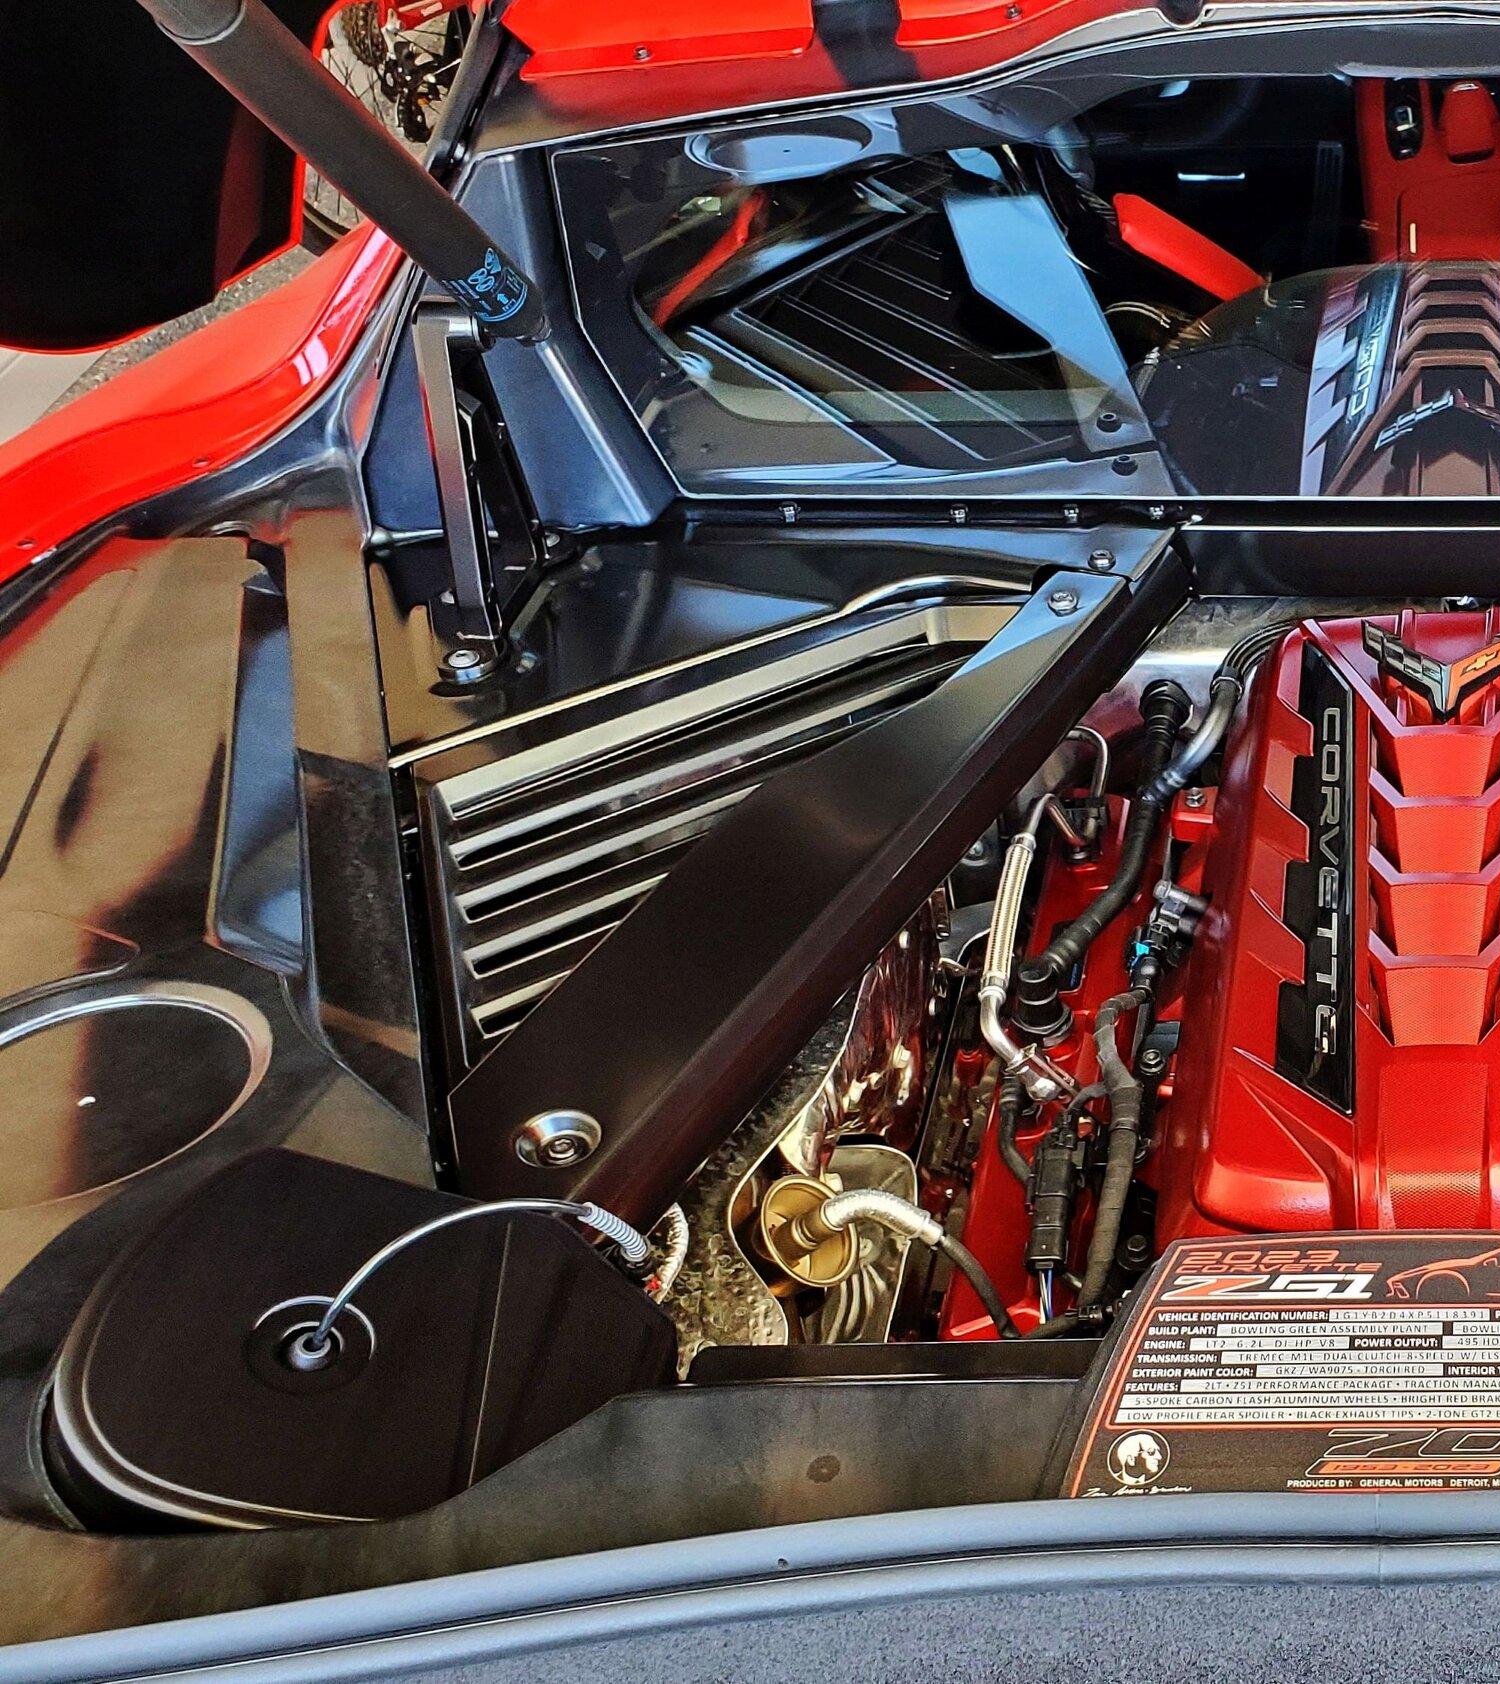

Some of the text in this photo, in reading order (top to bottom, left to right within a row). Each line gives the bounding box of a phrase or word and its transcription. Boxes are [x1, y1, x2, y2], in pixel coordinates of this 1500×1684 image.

[1314, 707, 1341, 1055] CORVETTE
[1181, 1249, 1340, 1265] 2023
[1174, 1262, 1383, 1273] CORVETTE
[1160, 1273, 1375, 1301] Z51
[1158, 1312, 1199, 1321] VEHICLE
[1201, 1311, 1279, 1321] IDENTIFICATION
[1280, 1311, 1329, 1320] NUMBER:
[1148, 1326, 1179, 1335] BUILD
[1181, 1326, 1216, 1335] PLANT:
[1230, 1325, 1285, 1334] BOWLING
[1289, 1325, 1327, 1334] GREEN
[1330, 1324, 1388, 1333] ASSEMBLY
[1392, 1324, 1428, 1333] PLANT
[1144, 1340, 1186, 1350] ENGINE:
[1206, 1340, 1226, 1348] LT2
[1237, 1340, 1263, 1348] 6.2L
[1354, 1338, 1393, 1347] POWER
[1394, 1338, 1438, 1347] OUTPUT:
[1457, 1337, 1478, 1346] 495
[1136, 1354, 1217, 1363] TRANSMISSION:
[1238, 1353, 1284, 1362] TREMEC
[1323, 1352, 1353, 1361] DUAL
[1357, 1352, 1400, 1360] CLUTCH
[1407, 1352, 1454, 1360] 8-SPEED
[1461, 1352, 1476, 1361] W/
[1132, 1368, 1181, 1378] EXTERIOR
[1183, 1368, 1213, 1377] PAINT
[1215, 1368, 1254, 1377] COLOR:
[1275, 1367, 1297, 1375] GKZ
[1309, 1366, 1353, 1375] WA9075
[1364, 1366, 1400, 1374] TORCH
[1404, 1366, 1425, 1374] RED
[1448, 1366, 1496, 1375] INTERIOR
[1125, 1383, 1178, 1392] FEATURES:
[1205, 1381, 1222, 1390] 2LT
[1256, 1381, 1338, 1390] PERFORMANCE
[1343, 1380, 1393, 1389] PACKAGE
[1404, 1380, 1459, 1389] TRACTION
[1135, 1396, 1183, 1405] 5-SPOKE
[1186, 1396, 1232, 1405] CARBON
[1236, 1396, 1271, 1404] FLASH
[1274, 1395, 1341, 1404] ALUMINUM
[1345, 1395, 1389, 1404] WHEELS
[1401, 1395, 1442, 1403] BRIGHT
[1446, 1395, 1468, 1403] RED
[1127, 1412, 1153, 1420] LOW
[1156, 1411, 1202, 1420] PROFILE
[1206, 1411, 1235, 1420] REAR
[1239, 1411, 1284, 1419] SPOILER
[1296, 1410, 1331, 1419] BLACK
[1335, 1410, 1386, 1418] EXHAUST
[1391, 1410, 1414, 1418] TIPS
[1426, 1410, 1466, 1418] 2-TONE
[1471, 1410, 1492, 1418] GT2
[1286, 1479, 1336, 1488] PRODUCED
[1338, 1479, 1353, 1488] BY:
[1359, 1479, 1402, 1488] GENERAL
[1404, 1479, 1443, 1487] MOTORS
[1450, 1479, 1490, 1488] DETROIT,
